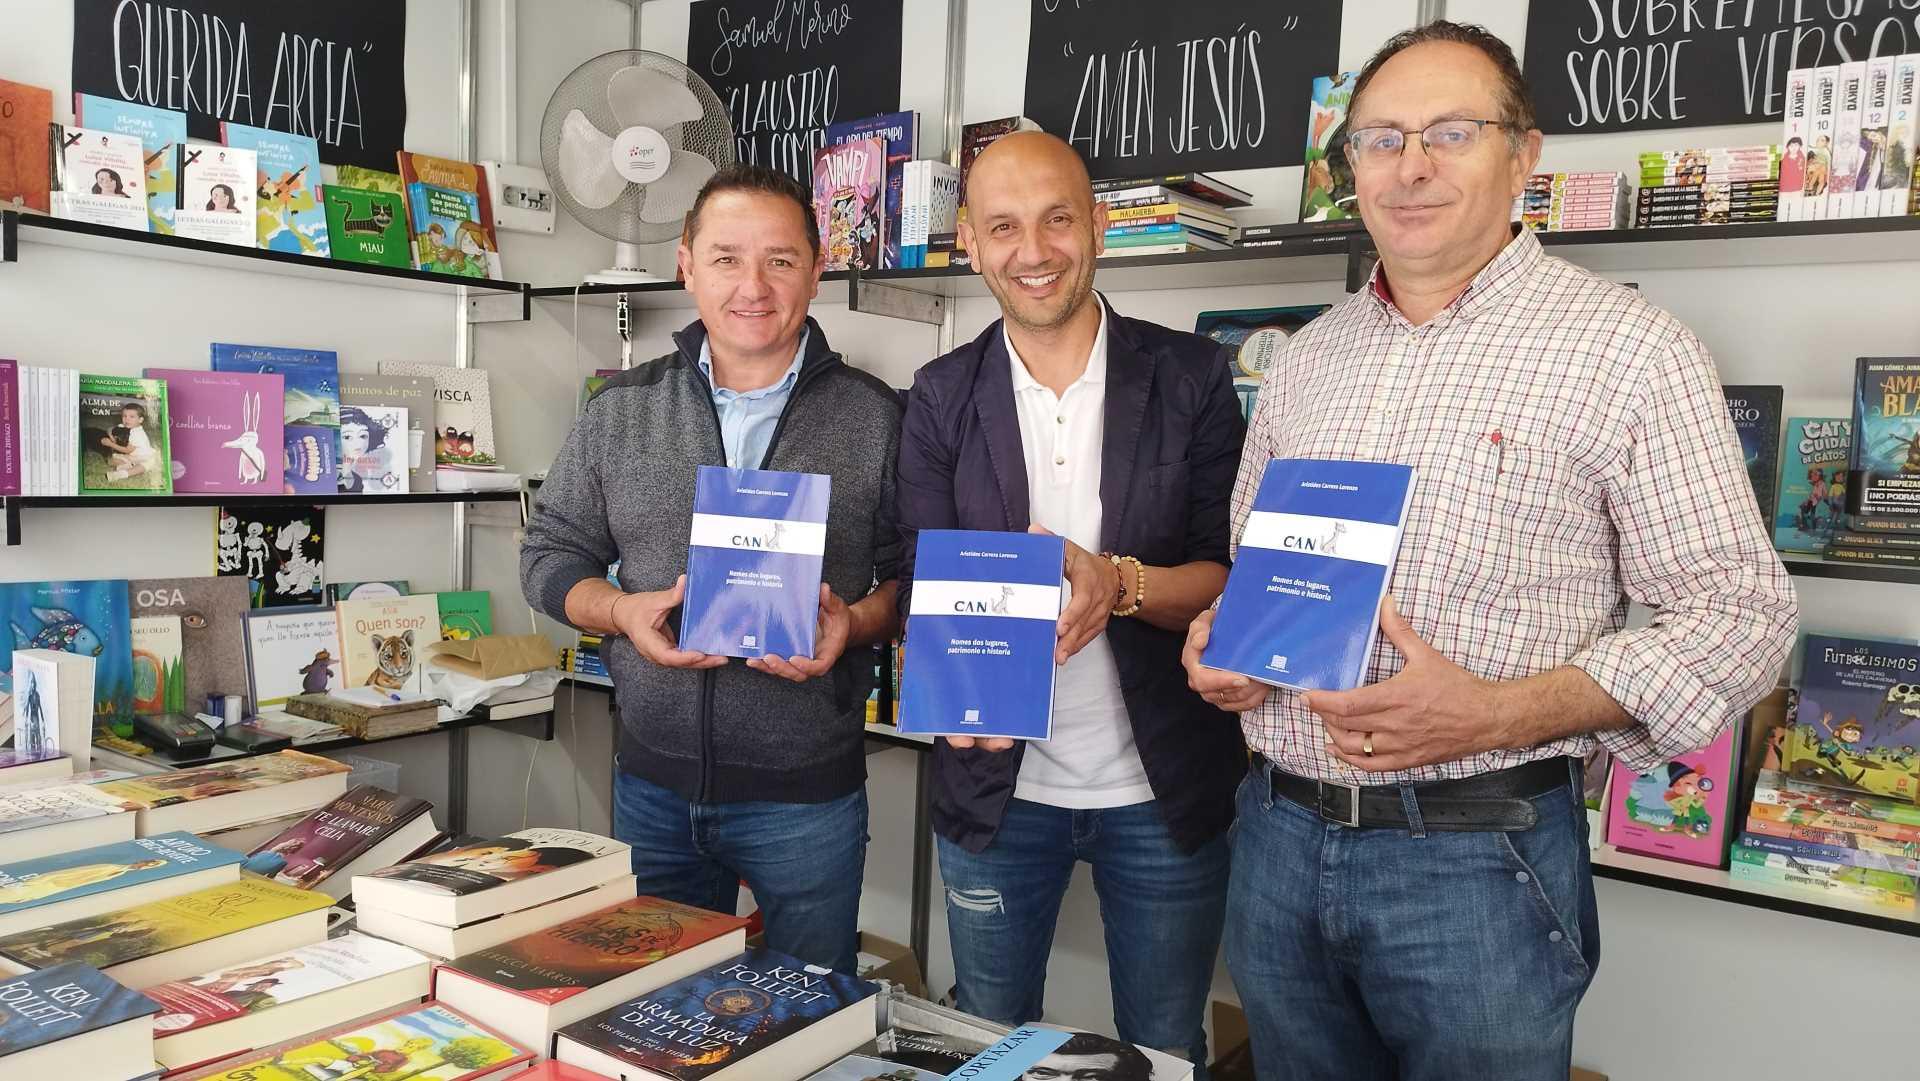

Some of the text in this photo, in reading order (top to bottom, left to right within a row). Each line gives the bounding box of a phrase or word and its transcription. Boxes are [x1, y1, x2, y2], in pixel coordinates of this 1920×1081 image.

[711, 0, 784, 76] Samuel
[113, 0, 253, 125] QUERIDA
[1169, 22, 1265, 154] JESÚS
[1567, 39, 1692, 126] SOBRE
[1902, 71, 1914, 105] TOKYO
[1822, 82, 1832, 115] TOKYO
[1848, 78, 1859, 111] TOKYO
[1874, 74, 1887, 108] TOKYO
[1794, 85, 1805, 118] TOKYO
[1869, 113, 1881, 124] 12
[1898, 110, 1906, 120] 2
[1816, 120, 1828, 130] 10
[876, 126, 902, 142] TIEMPO
[1120, 207, 1156, 218] MALAHERBA
[360, 242, 384, 254] MIAU
[386, 385, 400, 396] de
[402, 386, 423, 399] paz
[81, 398, 108, 407] ALMA
[92, 408, 111, 416] CAN
[1801, 452, 1847, 465] DE GATOS
[732, 535, 762, 548] CAN
[1284, 536, 1316, 550] CAN
[1272, 576, 1293, 586] Nomes
[1294, 578, 1305, 586] dos
[136, 588, 186, 608] OSA
[1266, 584, 1300, 596] patrimonio
[1306, 590, 1331, 601] historia
[954, 600, 987, 613] CAN
[356, 616, 426, 634] Quen son?
[950, 638, 972, 646] Nomes
[948, 647, 980, 655] patrimonio
[987, 647, 1011, 656] historia
[315, 811, 380, 837] TE LLAMARÉ
[314, 826, 346, 841] CELIA
[720, 964, 830, 1005] FOLLETT
[766, 965, 824, 990] KEN
[45, 982, 101, 1008] KEN
[0, 981, 82, 1027] FOLLETT
[627, 1000, 750, 1047] ARMADURA
[694, 1011, 713, 1023] LA
[597, 1022, 613, 1032] LOS
[620, 1010, 720, 1052] DE LA LUZ
